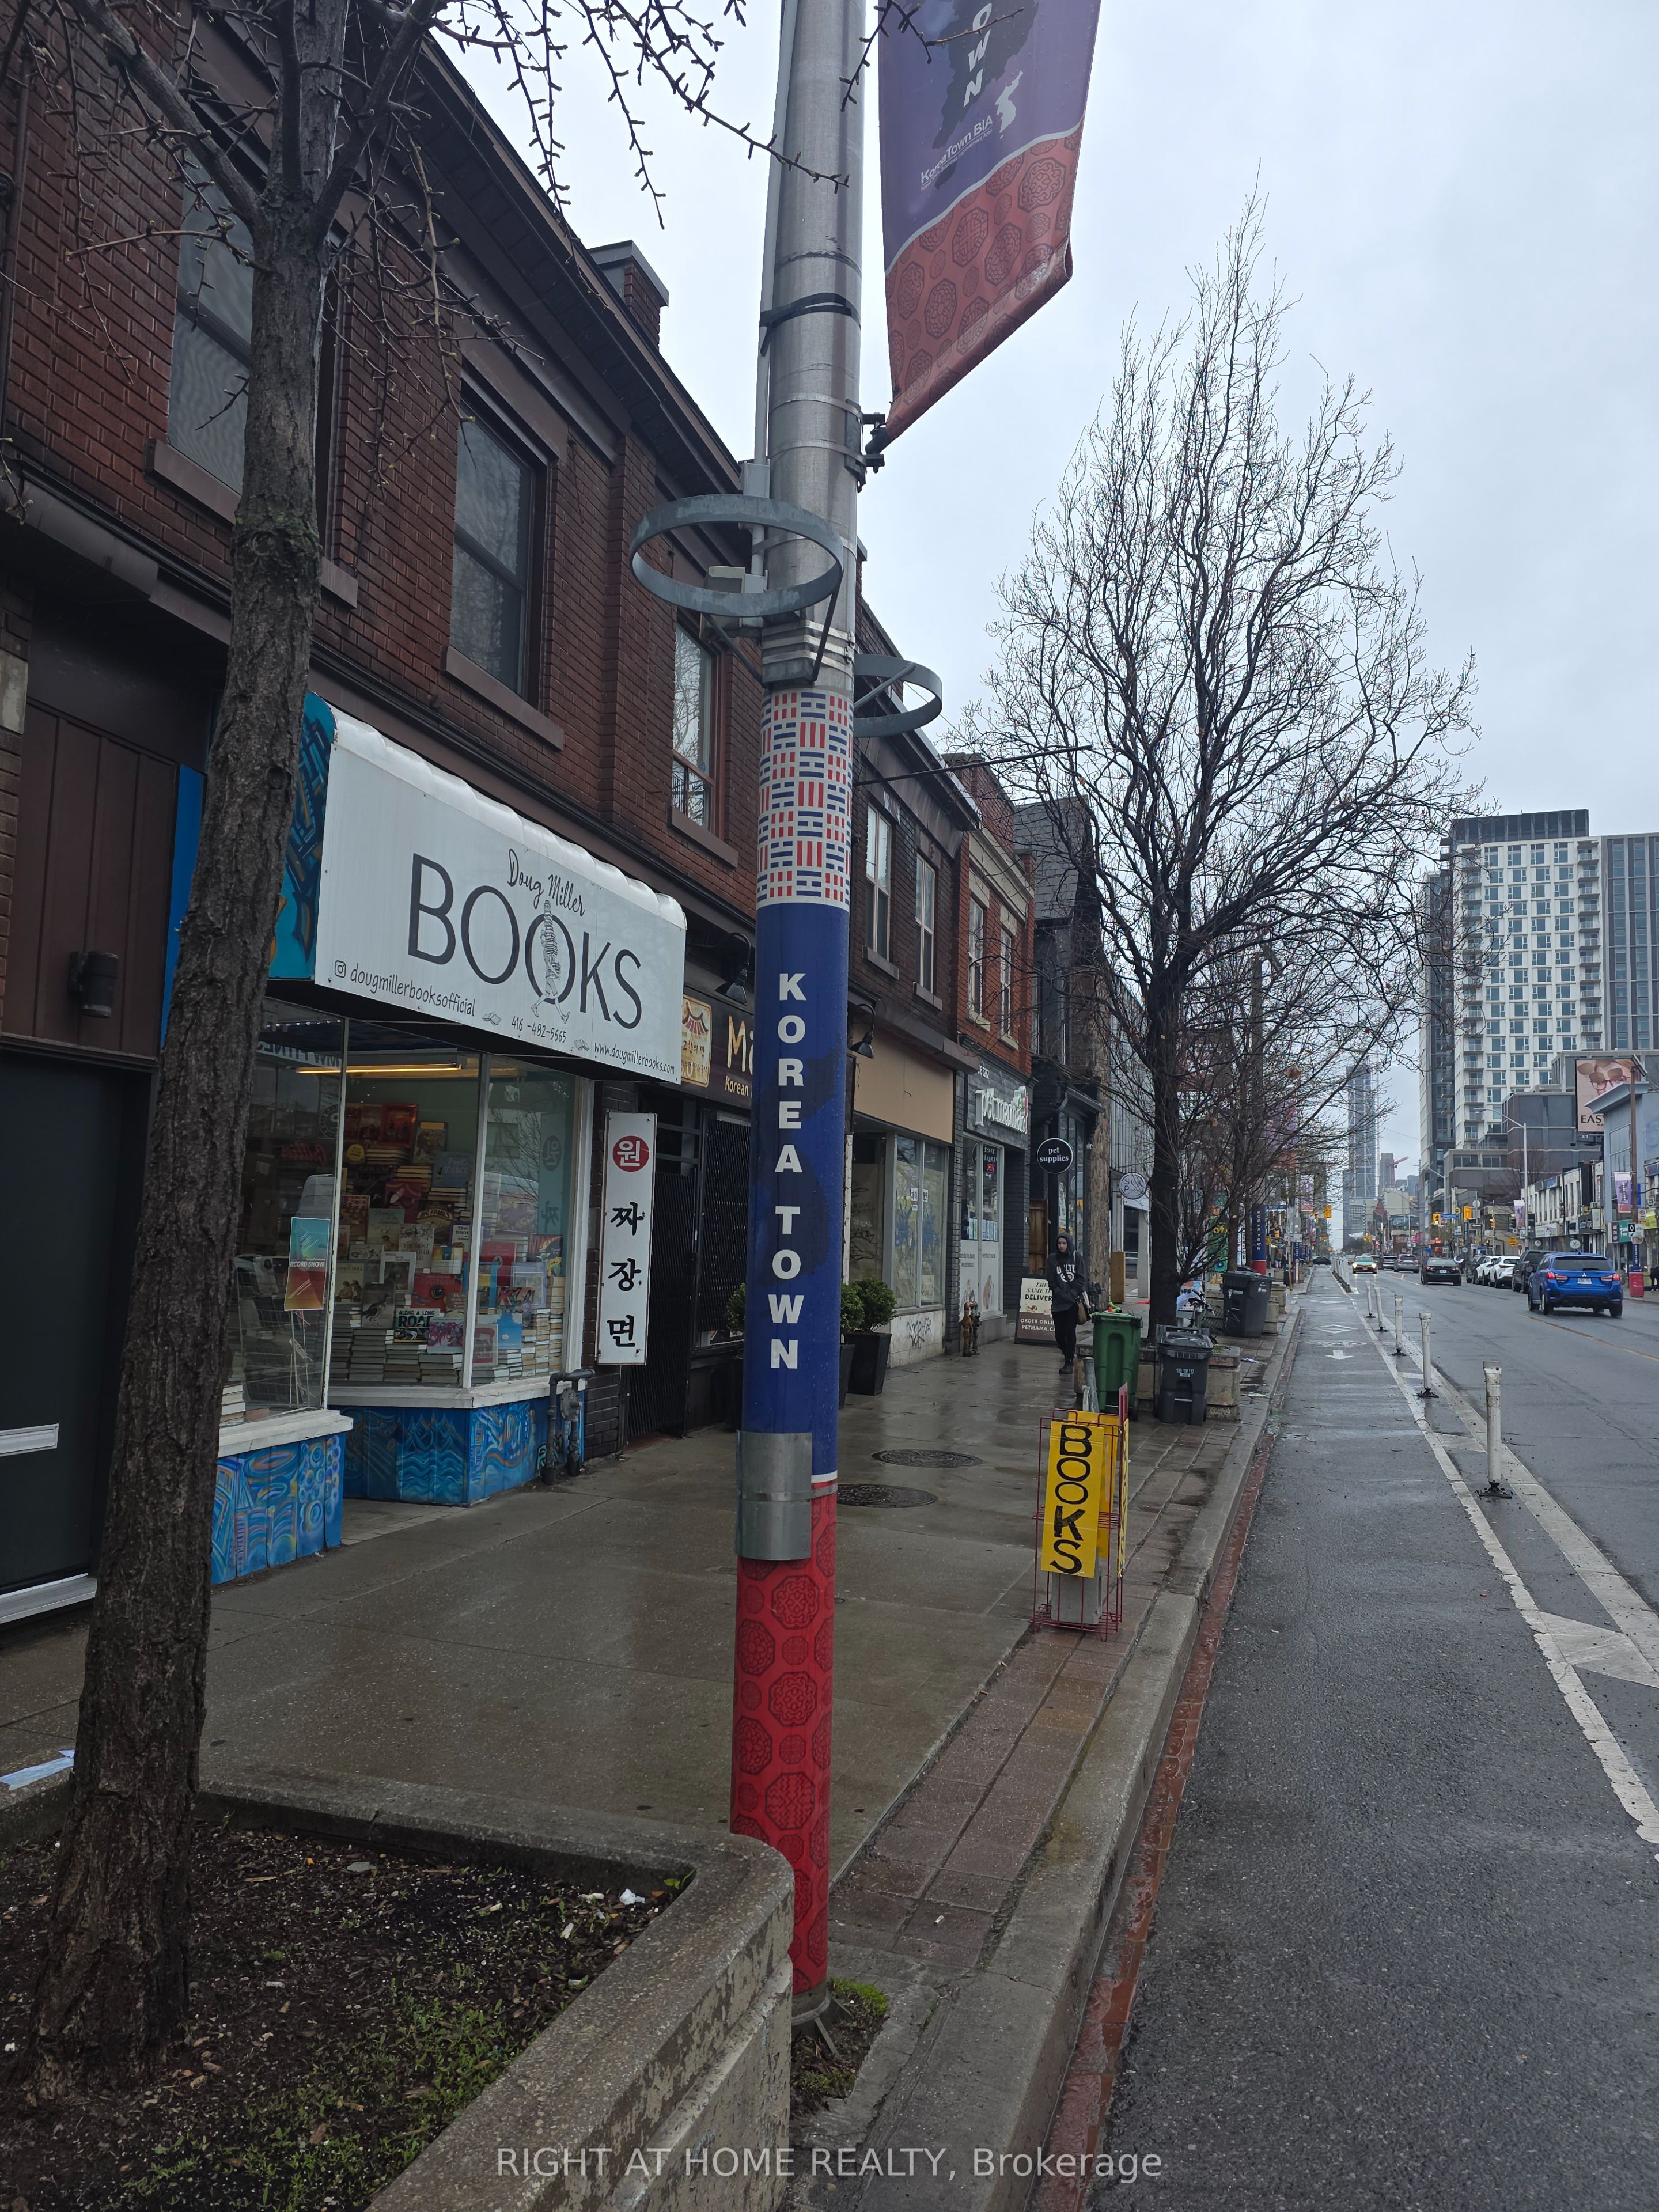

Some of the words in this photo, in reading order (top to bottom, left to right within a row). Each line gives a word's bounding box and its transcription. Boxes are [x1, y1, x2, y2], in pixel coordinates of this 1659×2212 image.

[974, 115, 993, 137] BIA
[507, 848, 544, 910] Doug
[548, 874, 585, 916] Miller
[408, 853, 641, 1029] BOOKS
[350, 963, 475, 1017] dougmillerbooksofficial
[512, 1016, 524, 1031] 416
[594, 1042, 675, 1075] www.dougmillerbooks.com
[775, 972, 807, 1173] KOREA
[725, 1075, 749, 1096] Korean
[617, 1140, 641, 1167] 원
[1040, 1154, 1069, 1163] supplies
[1048, 1146, 1059, 1154] pet
[607, 1202, 644, 1347] 짜장면
[768, 1206, 804, 1369] TOWN
[1050, 1424, 1092, 1574] BOOKS
